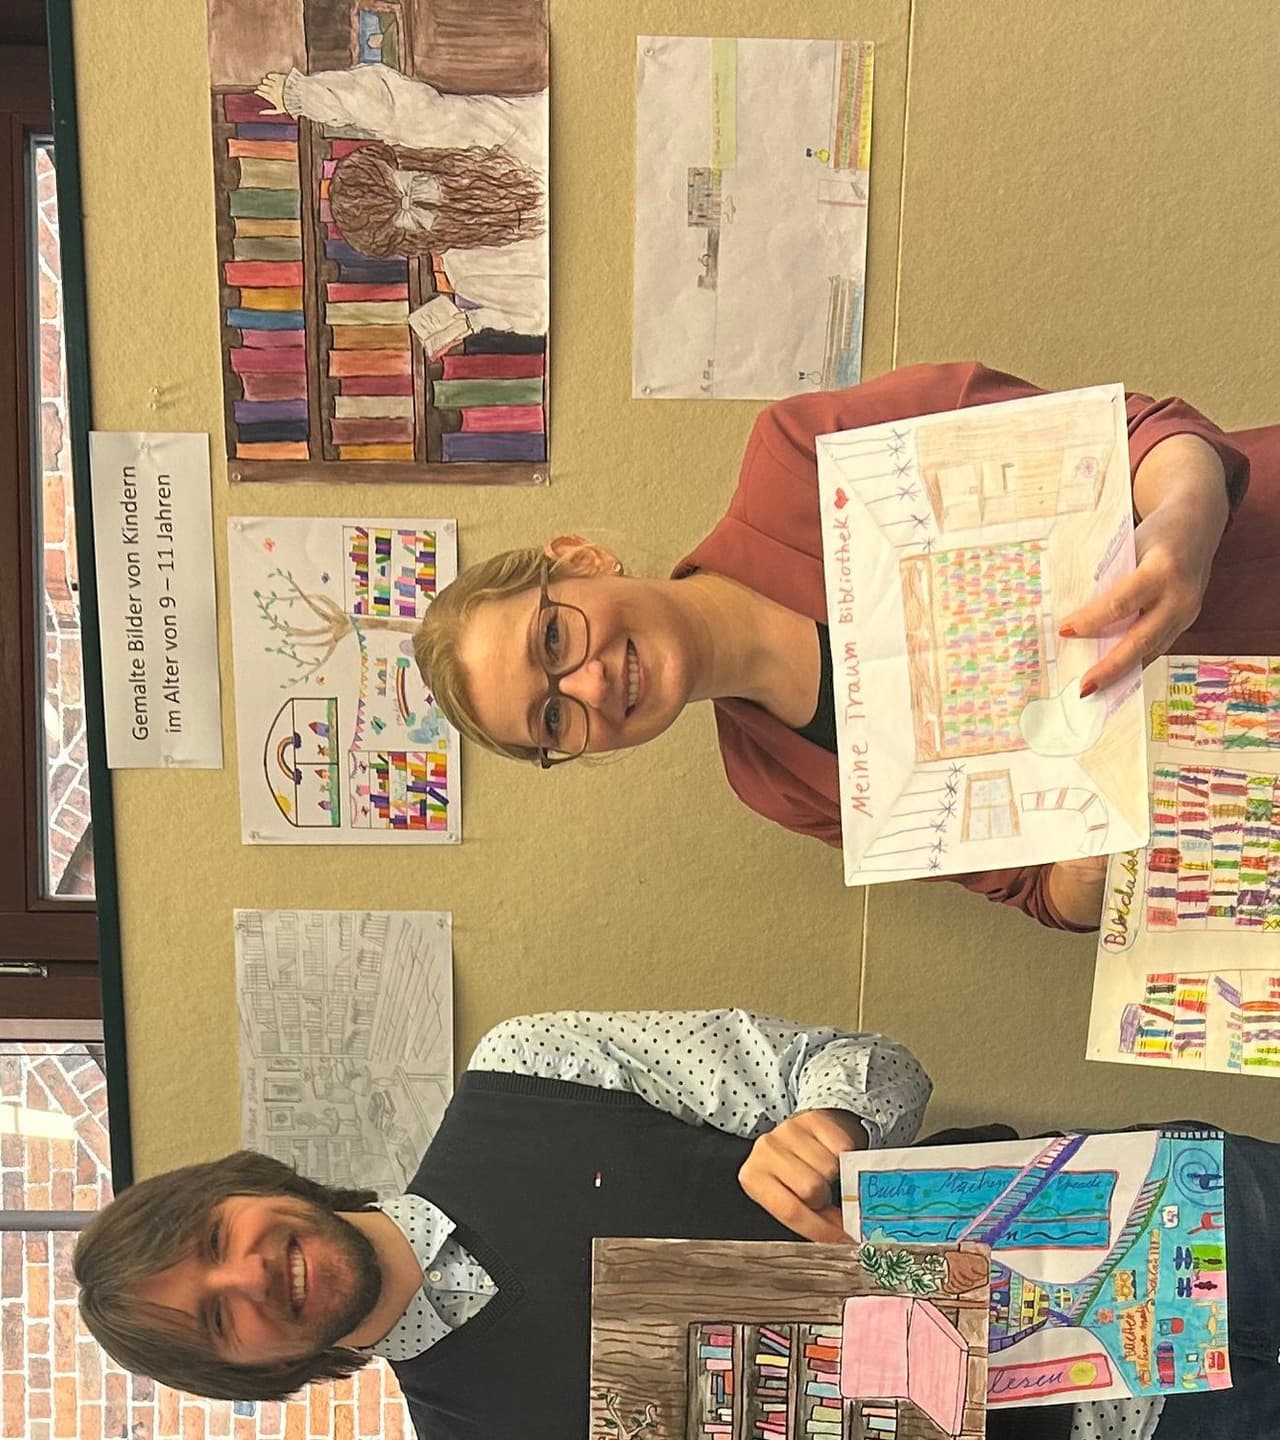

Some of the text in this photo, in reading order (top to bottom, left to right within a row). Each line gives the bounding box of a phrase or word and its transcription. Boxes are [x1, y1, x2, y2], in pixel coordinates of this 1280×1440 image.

[155, 474, 174, 543] Jahren
[157, 548, 176, 572] 11
[120, 465, 150, 741] Gemalte Bilder von Kindern
[159, 595, 177, 609] 9
[163, 614, 179, 651] von
[162, 656, 181, 705] Alter
[831, 512, 873, 819] Meine Traum Bibliothek
[164, 710, 183, 734] im
